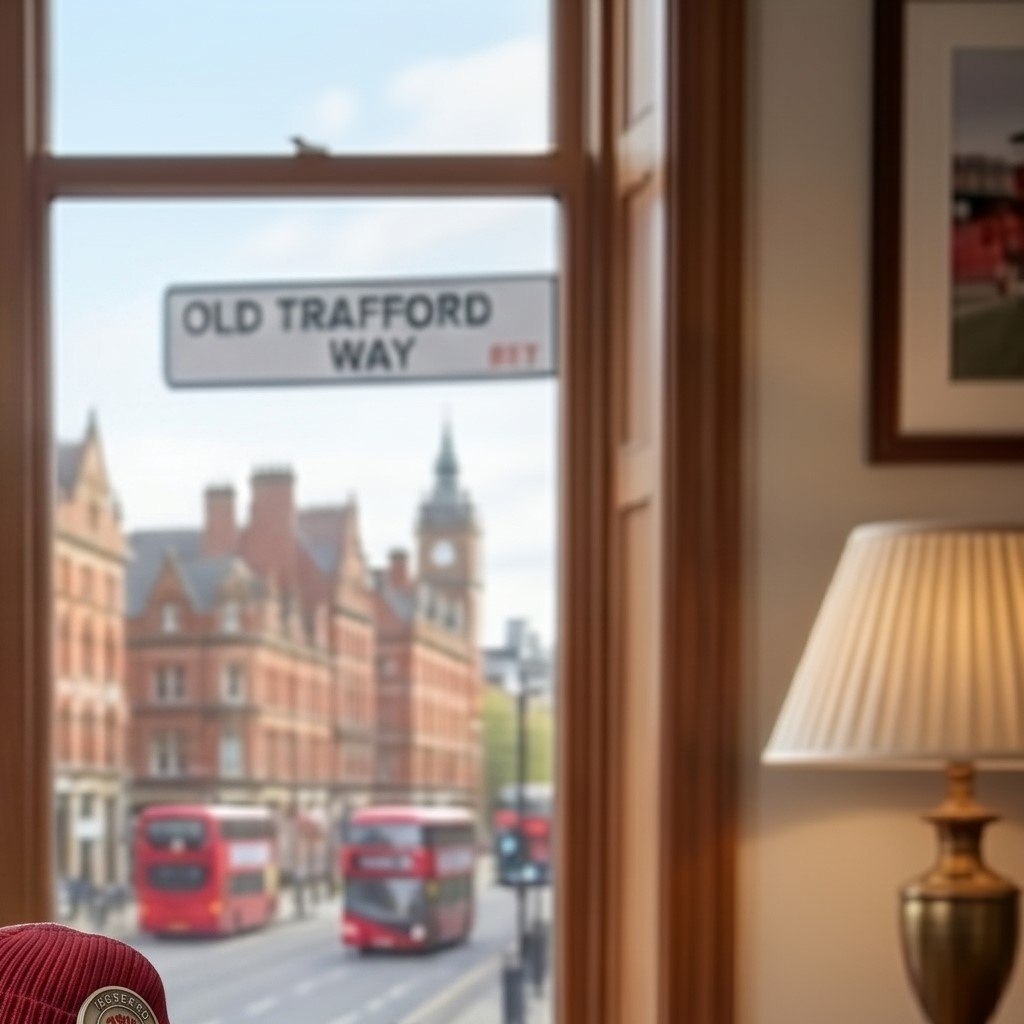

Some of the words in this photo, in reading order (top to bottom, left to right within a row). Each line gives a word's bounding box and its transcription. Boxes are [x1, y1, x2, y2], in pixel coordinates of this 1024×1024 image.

[182, 299, 263, 336] OLD
[277, 291, 493, 333] TRAFFORD
[329, 336, 416, 373] WAY
